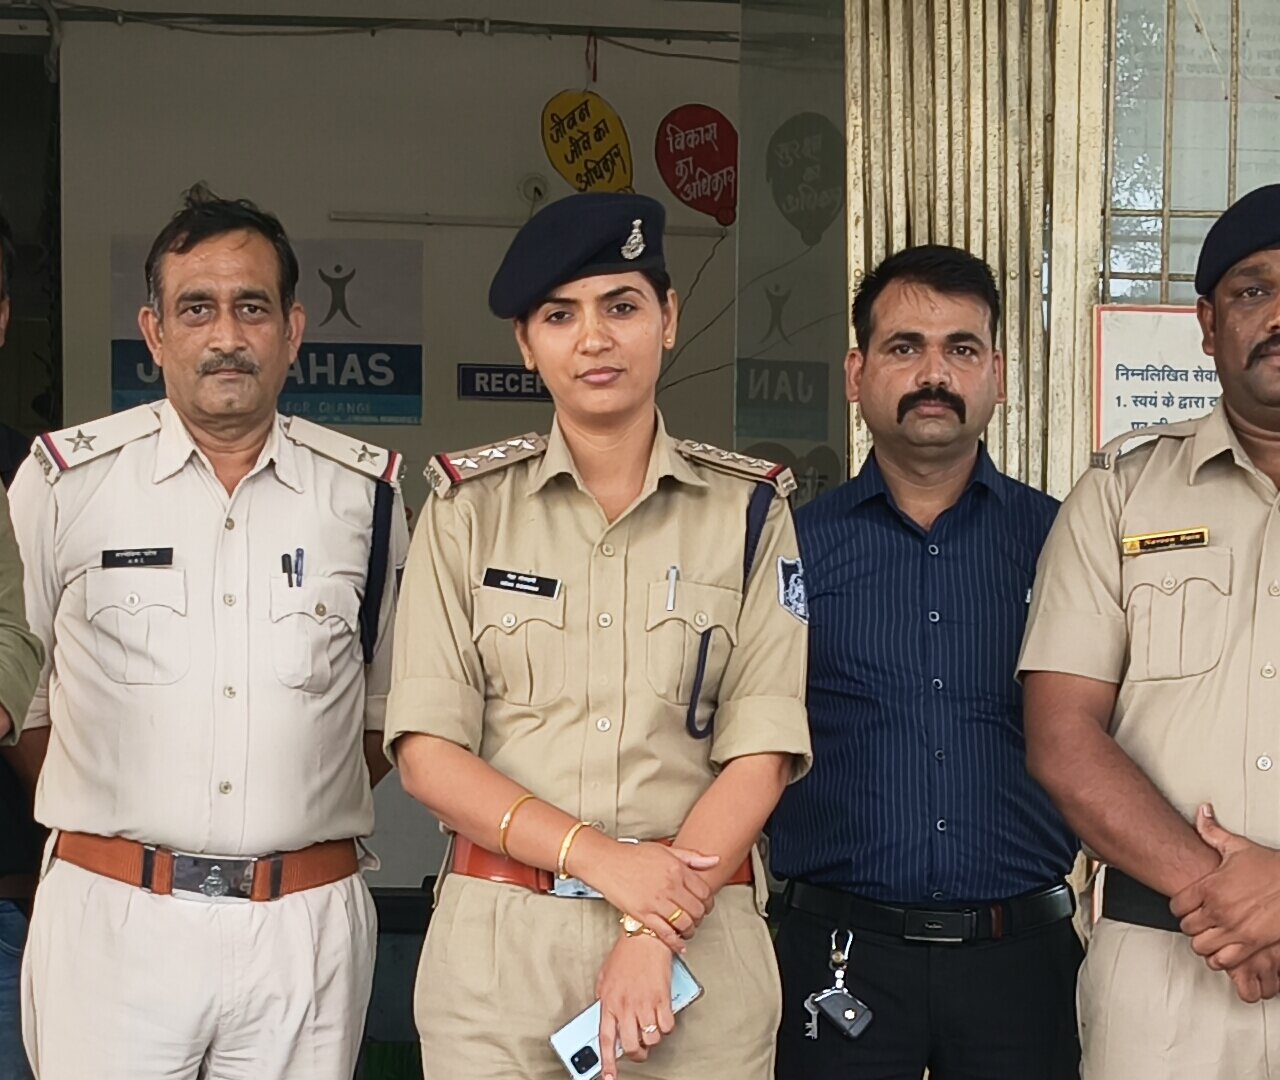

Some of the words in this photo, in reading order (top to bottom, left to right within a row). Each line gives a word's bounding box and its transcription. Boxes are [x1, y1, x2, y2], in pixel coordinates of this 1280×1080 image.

[549, 99, 592, 144] जीवन
[593, 118, 611, 141] का
[666, 122, 719, 153] विकास
[675, 156, 694, 189] का
[681, 164, 736, 202] अधिकार
[287, 352, 396, 387] AHAS
[1115, 363, 1189, 383] निम्नलिखित
[1193, 366, 1219, 383] सेवा
[1116, 395, 1127, 408] 1.
[1132, 391, 1158, 408] स्वयं
[1162, 391, 1175, 408] के
[1178, 395, 1205, 410] द्वारा
